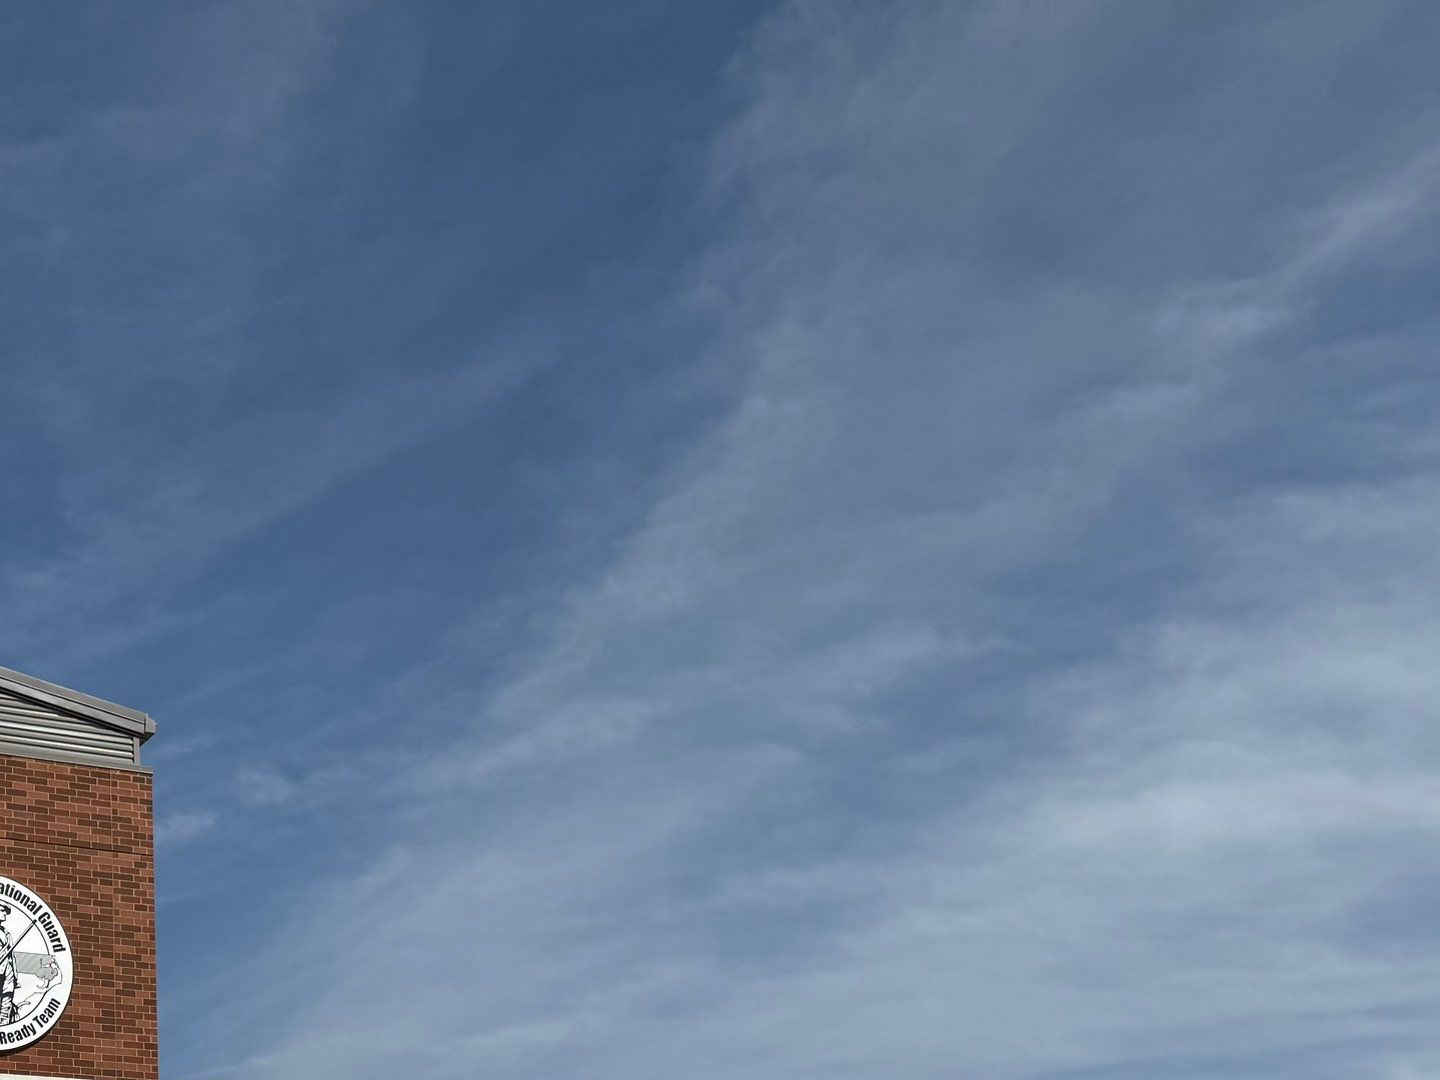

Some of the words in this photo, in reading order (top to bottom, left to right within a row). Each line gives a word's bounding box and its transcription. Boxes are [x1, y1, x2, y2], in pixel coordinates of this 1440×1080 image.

[37, 911, 67, 953] Guard
[0, 1018, 37, 1045] Ready
[33, 997, 61, 1030] Team
